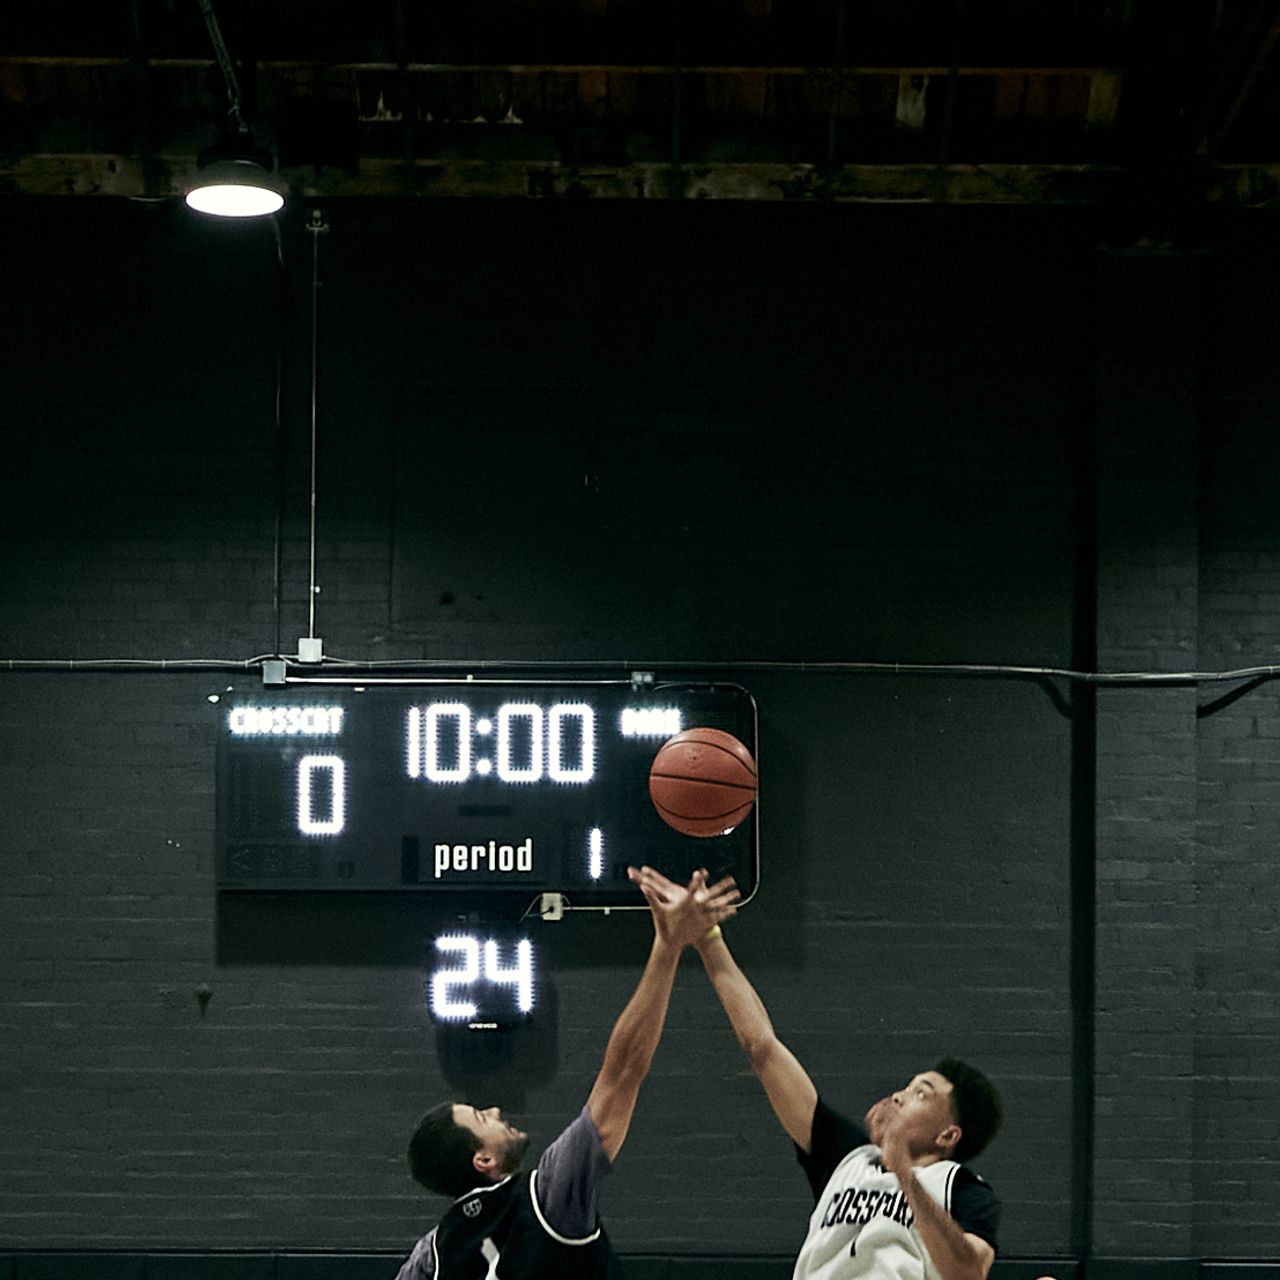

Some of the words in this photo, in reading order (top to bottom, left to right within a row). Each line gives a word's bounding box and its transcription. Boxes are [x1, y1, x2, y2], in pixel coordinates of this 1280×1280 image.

[408, 702, 595, 783] 10:00
[298, 754, 346, 835] 0
[434, 838, 533, 879] period
[590, 828, 601, 879] 1
[431, 934, 532, 1020] 24
